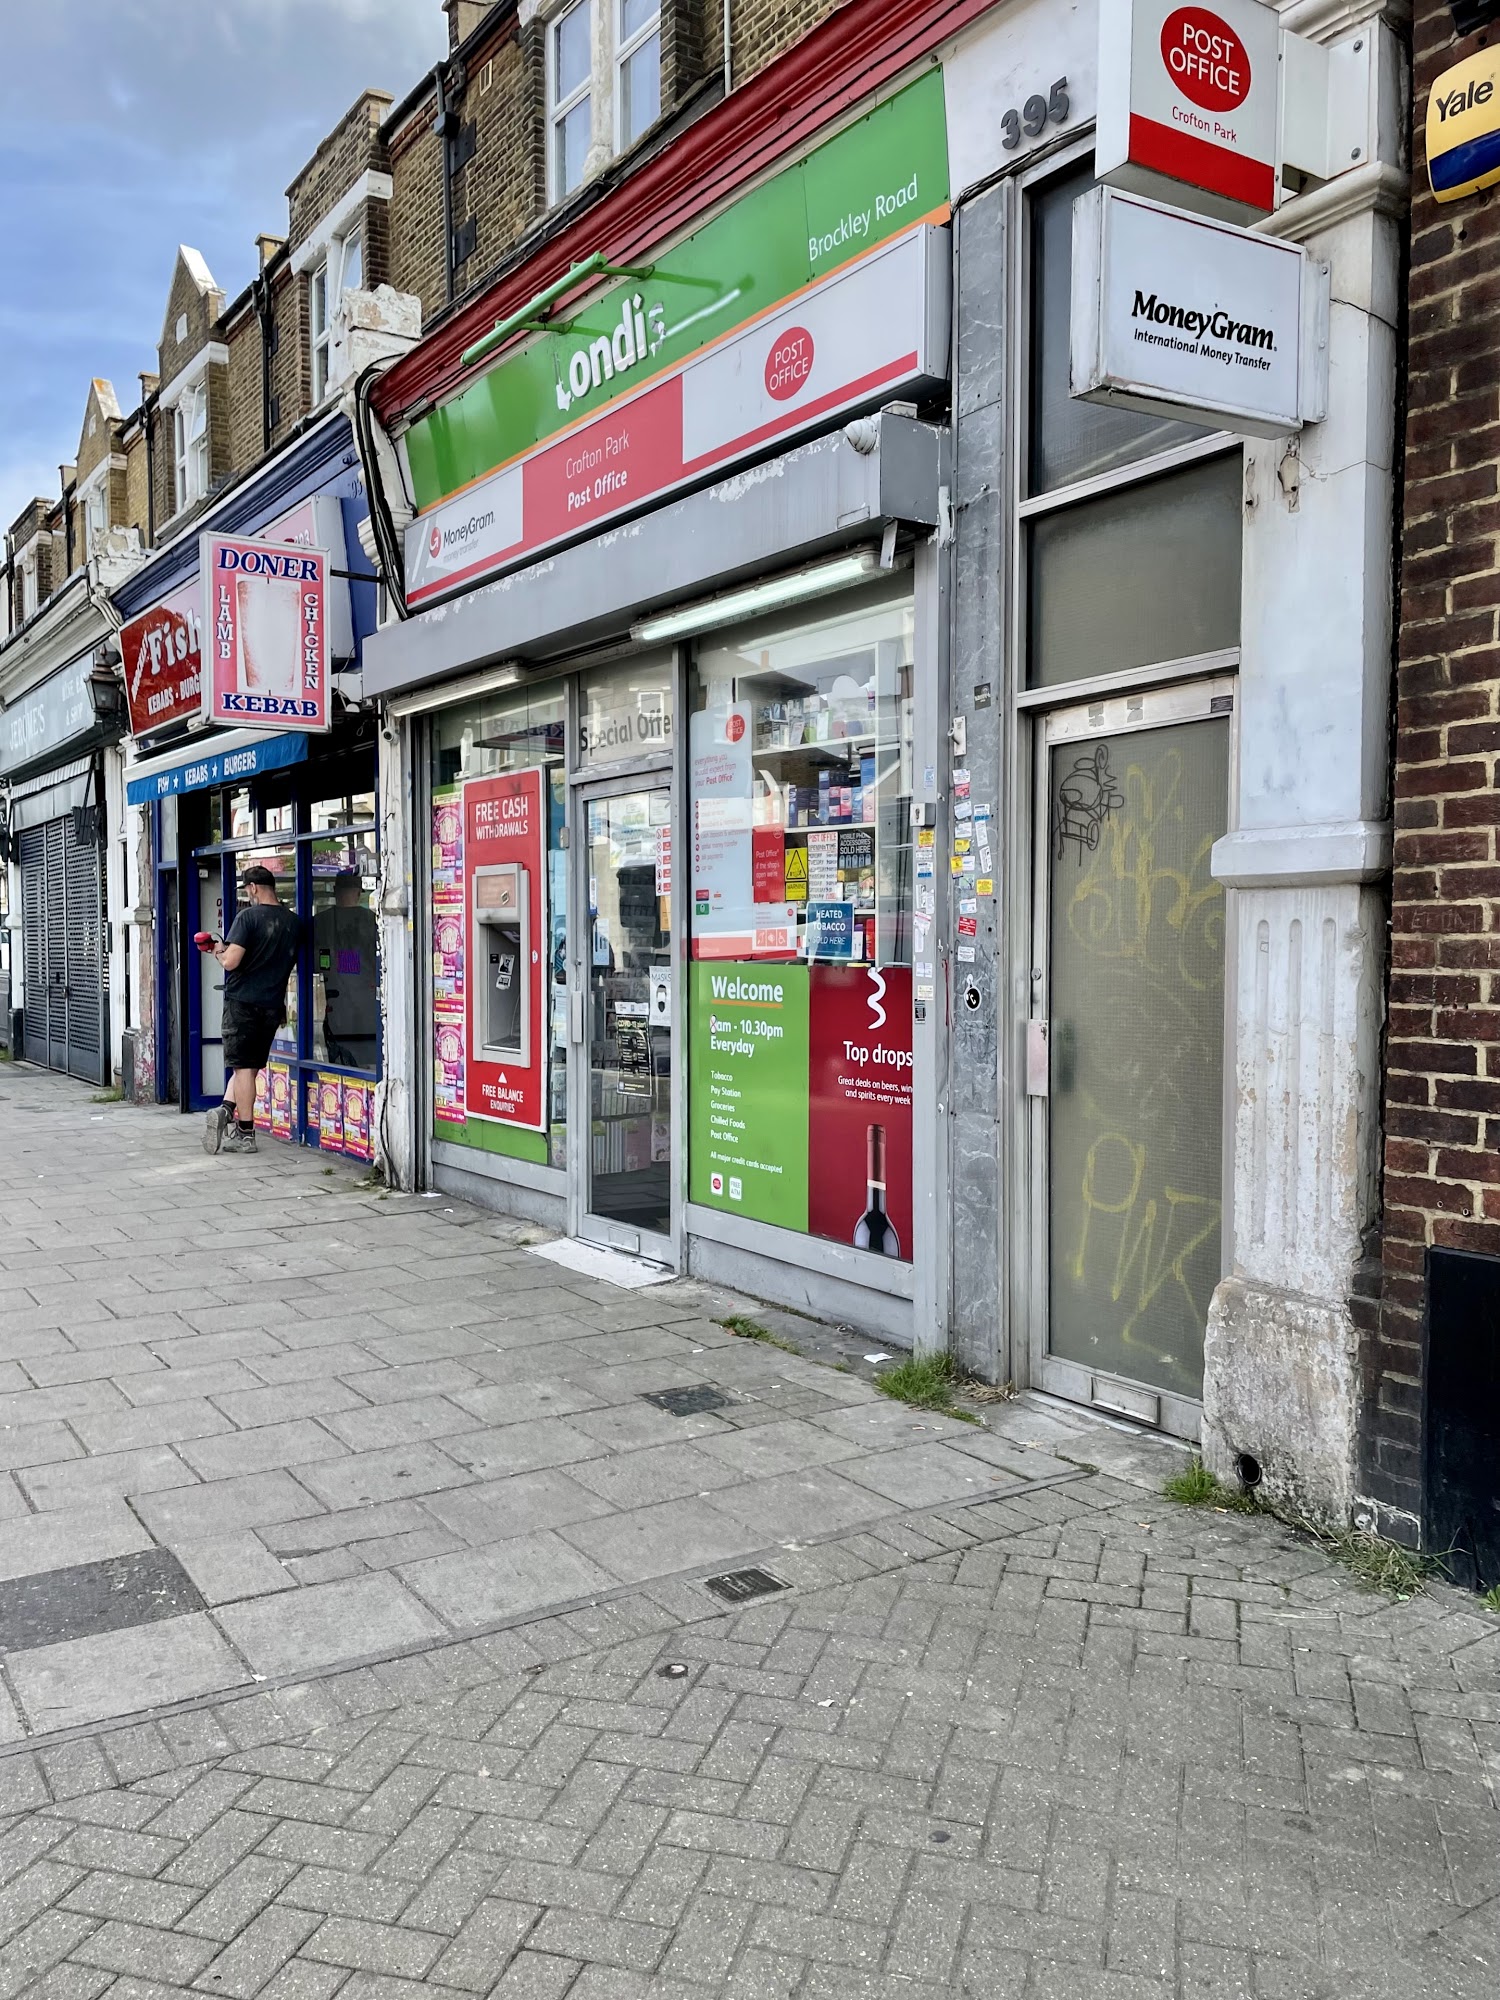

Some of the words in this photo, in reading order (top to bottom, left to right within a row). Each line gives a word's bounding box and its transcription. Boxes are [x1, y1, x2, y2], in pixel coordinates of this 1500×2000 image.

[1183, 23, 1234, 64] POST
[1169, 47, 1240, 95] OFFICE
[1001, 76, 1070, 150] 395
[1436, 80, 1494, 123] Yale
[1172, 106, 1210, 133] Crofton
[1214, 122, 1237, 143] Park
[808, 209, 871, 262] Brockley
[875, 173, 918, 221] Road
[1131, 290, 1274, 351] MoneyGram
[775, 338, 805, 369] POST
[1134, 328, 1199, 355] International
[1200, 344, 1233, 365] Money
[1234, 352, 1272, 371] Transfer
[769, 356, 809, 391] OFFICE
[566, 448, 602, 479] Crofton
[605, 429, 630, 459] Park
[568, 486, 591, 512] Post
[594, 470, 628, 499] Office
[443, 511, 496, 549] MoneyGram
[217, 548, 319, 582] DONER
[216, 585, 234, 659] LAMB
[147, 608, 201, 676] Fish
[303, 593, 320, 690] CHICKEN
[148, 686, 175, 715] KEBABS
[179, 671, 201, 701] BURG
[222, 693, 319, 718] KEBAB
[637, 708, 673, 739] Offe
[184, 763, 209, 786] KEBABS
[223, 750, 257, 776] BURGERS
[475, 801, 500, 823] FREE
[502, 796, 529, 819] CASH
[476, 820, 529, 840] WITHDRAWALS
[813, 922, 846, 931] TOBACCO
[816, 910, 842, 919] HEATED
[830, 936, 846, 945] HERE
[711, 976, 783, 1002] Welcome
[740, 1019, 783, 1040] 10.30pm
[710, 1036, 755, 1058] Everyday
[843, 1041, 869, 1067] Top
[872, 1043, 913, 1071] drops
[710, 1070, 733, 1082] Tobacco
[838, 1075, 854, 1086] Great
[855, 1078, 871, 1088] deals
[882, 1080, 900, 1092] beers,
[482, 1084, 497, 1098] FREE
[498, 1086, 524, 1103] BALANCE
[710, 1085, 721, 1097] Pay
[721, 1086, 742, 1098] Station
[710, 1100, 735, 1112] Groceries
[845, 1089, 857, 1098] and
[858, 1091, 875, 1101] spirits
[877, 1094, 894, 1105] every
[895, 1096, 911, 1105] week
[490, 1100, 515, 1114] ENQUIRIES
[710, 1115, 729, 1126] Chilled
[729, 1117, 746, 1129] Foods
[710, 1129, 722, 1140] Post
[722, 1131, 739, 1143] Office
[717, 1153, 731, 1163] major
[732, 1155, 745, 1165] credit
[746, 1160, 760, 1169] cards
[760, 1162, 783, 1174] accepted
